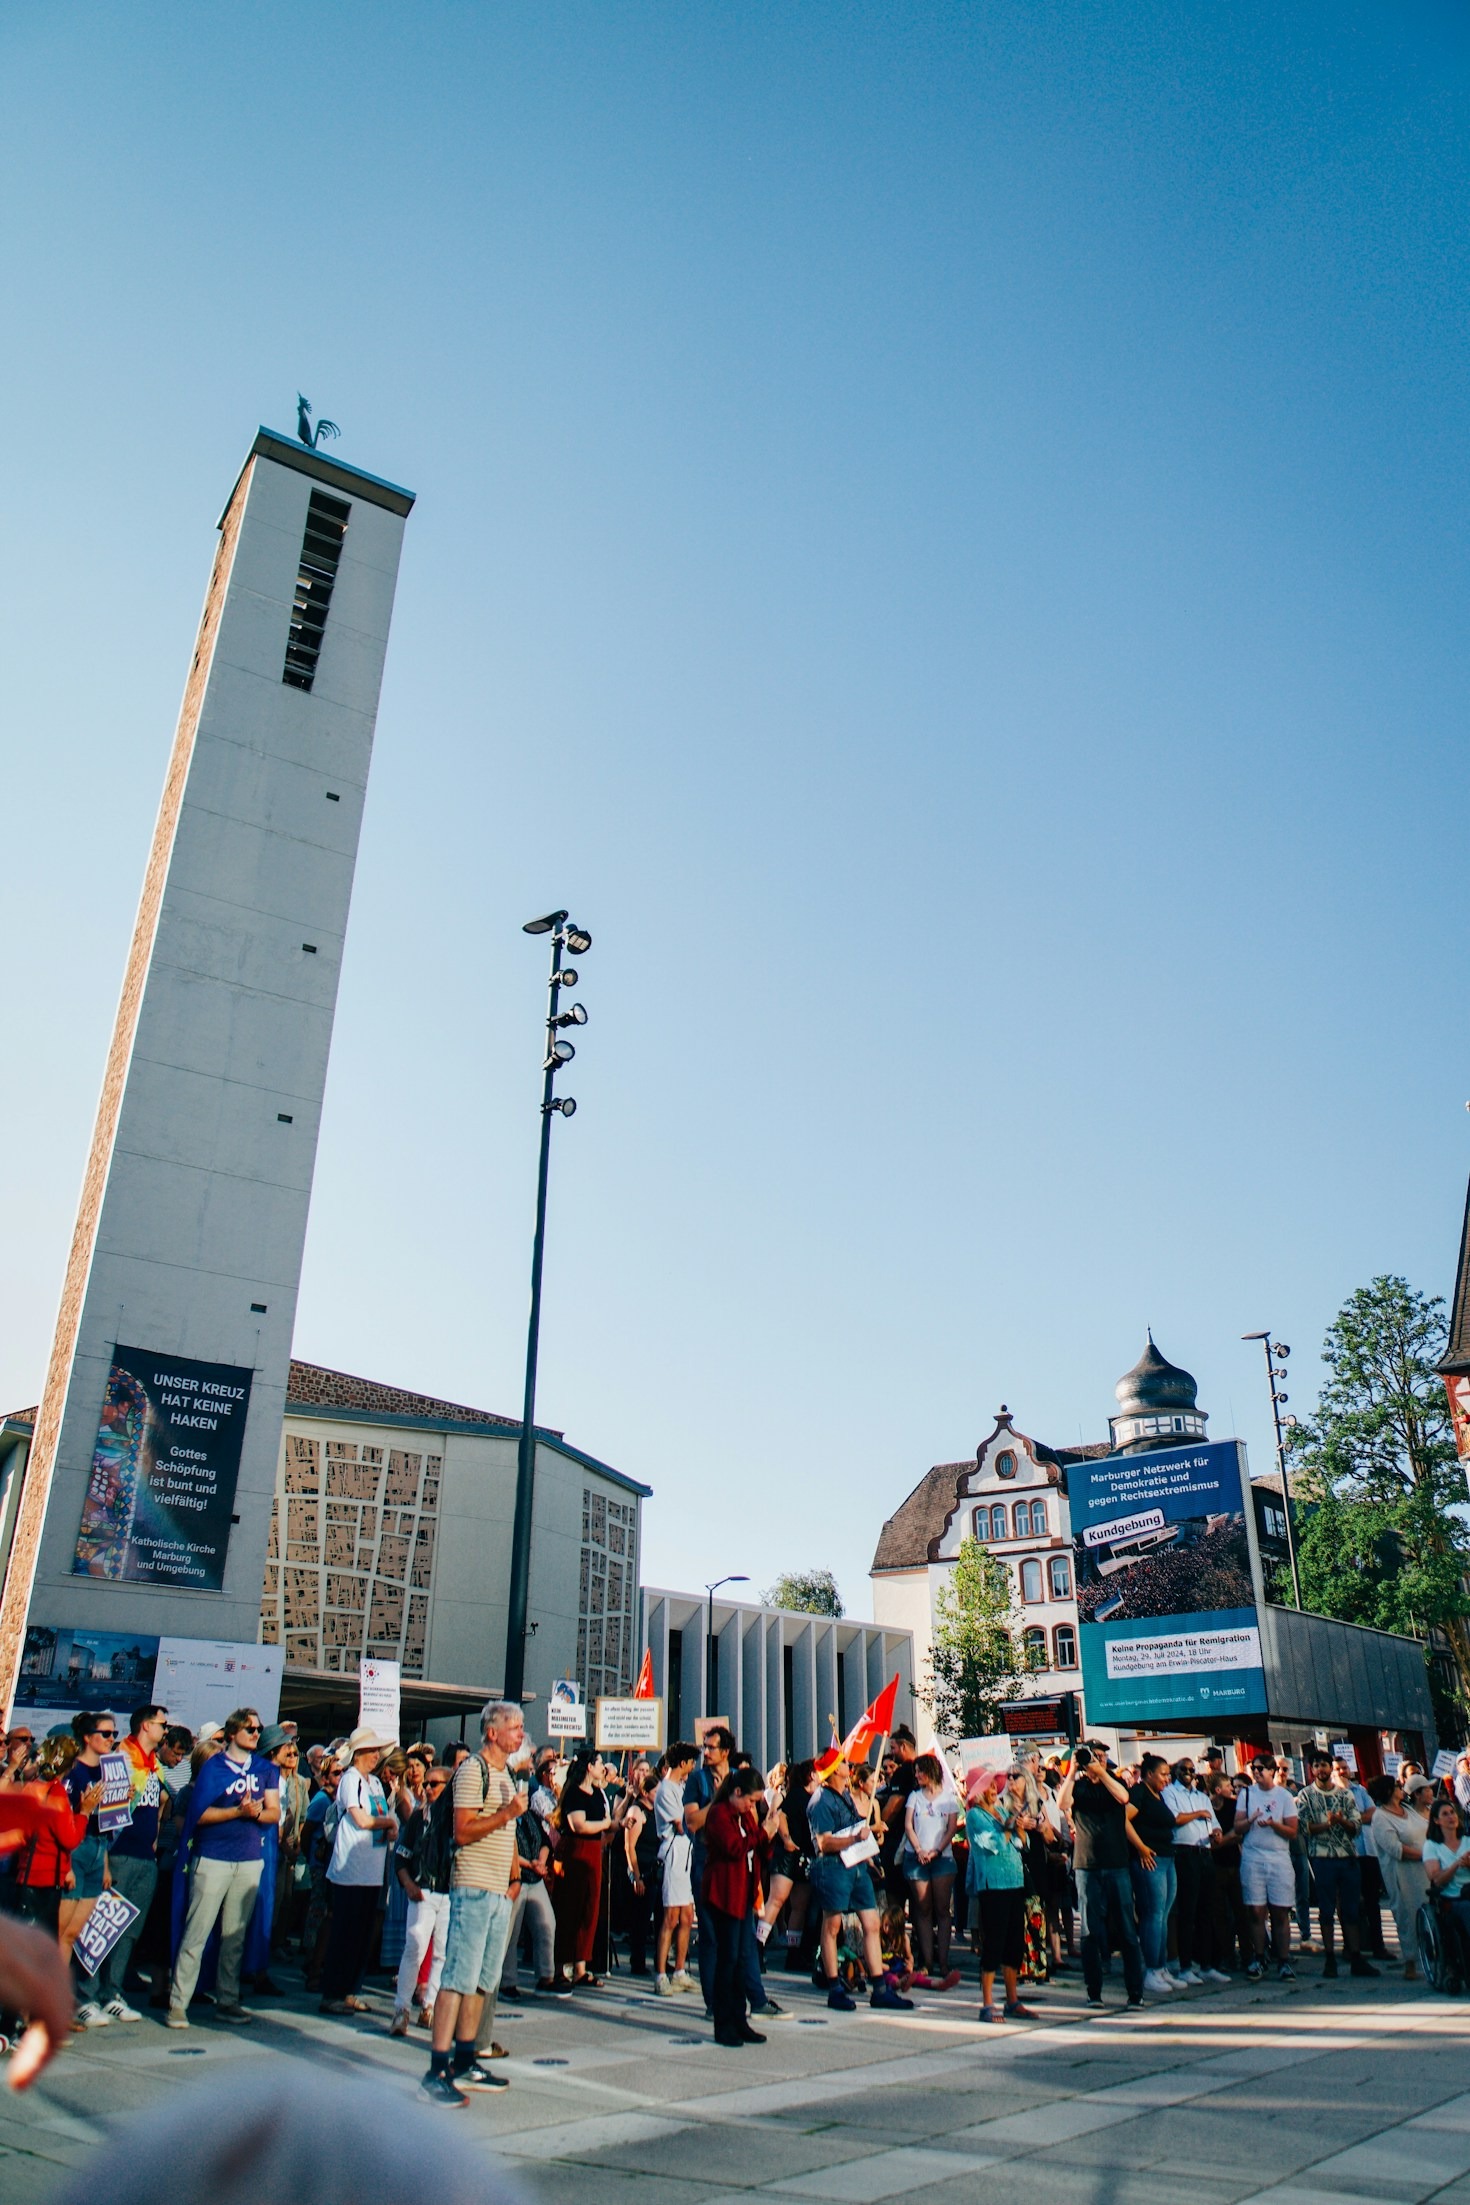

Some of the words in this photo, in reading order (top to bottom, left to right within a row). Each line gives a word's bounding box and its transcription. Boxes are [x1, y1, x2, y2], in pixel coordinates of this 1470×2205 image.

[153, 1374, 199, 1392] UNSER
[202, 1382, 245, 1400] KREUZ
[161, 1393, 190, 1408] HAT
[193, 1398, 232, 1415] KEINE
[170, 1413, 217, 1430] HAKEN
[170, 1446, 207, 1461] Gottes
[155, 1460, 216, 1480] Schöpfung
[1090, 1468, 1140, 1483] Marburger
[1143, 1460, 1191, 1474] Netzwerk
[1193, 1457, 1209, 1466] für
[149, 1475, 164, 1487] ist
[167, 1478, 192, 1491] bunt
[196, 1484, 217, 1495] und
[1111, 1476, 1168, 1491] Demokratie
[1171, 1472, 1190, 1482] und
[154, 1493, 207, 1511] vielfältig!
[1088, 1496, 1117, 1508] gegen
[1120, 1480, 1220, 1501] Rechtsextremismus
[1089, 1515, 1160, 1541] Kundgebung
[131, 1536, 185, 1550] Katholische
[187, 1543, 216, 1554] Kirche
[153, 1550, 191, 1565] Marburg
[137, 1561, 154, 1570] und
[156, 1562, 206, 1577] Umgebung
[1112, 1644, 1133, 1653] Keine
[1136, 1641, 1182, 1651] Propaganda
[1200, 1634, 1250, 1646] Remigration
[1154, 1650, 1165, 1659] Juli
[1167, 1650, 1186, 1658] 2024,
[1113, 1662, 1153, 1671] Kundgebung
[1213, 1687, 1245, 1697] MARBURG
[104, 1760, 127, 1781] NUR
[102, 1787, 129, 1804] STARK
[96, 1891, 130, 1927] CSD
[79, 1922, 107, 1958] AFD
